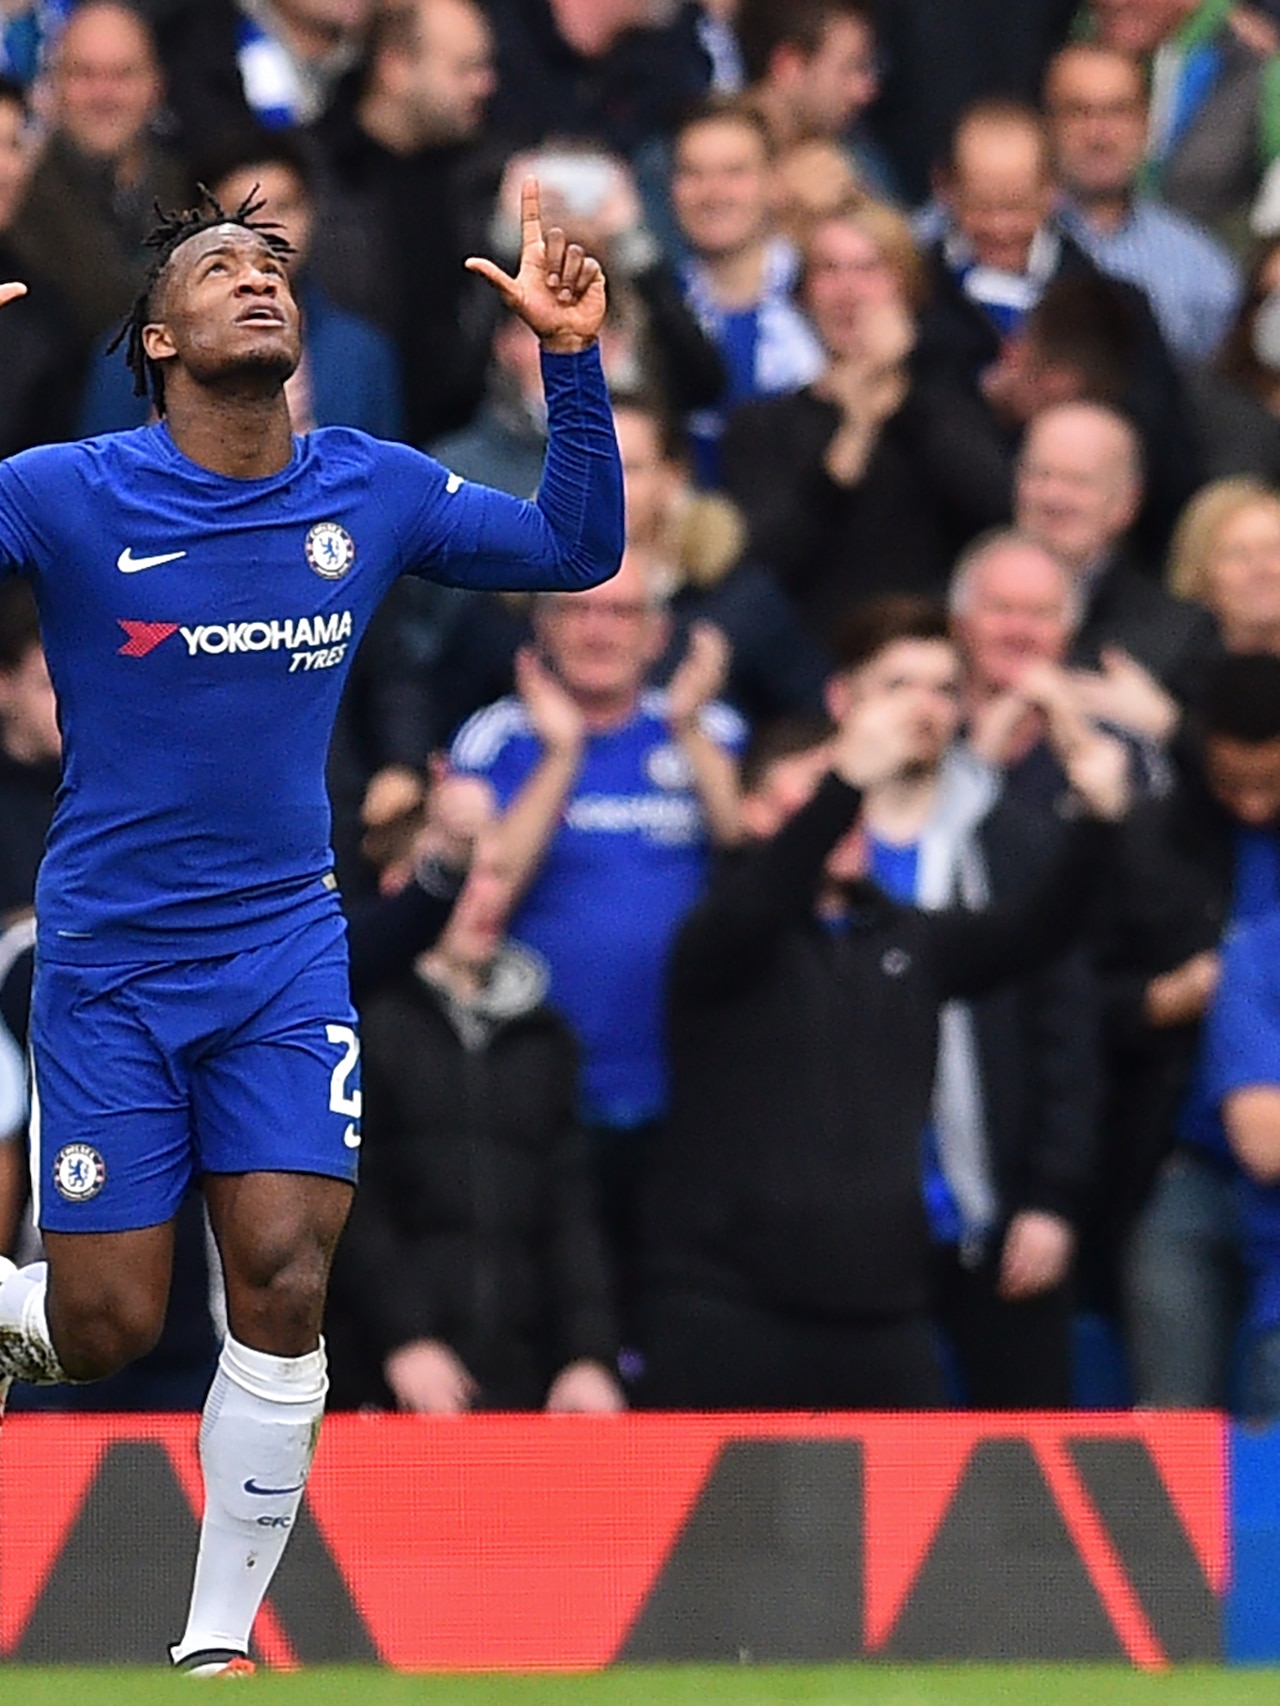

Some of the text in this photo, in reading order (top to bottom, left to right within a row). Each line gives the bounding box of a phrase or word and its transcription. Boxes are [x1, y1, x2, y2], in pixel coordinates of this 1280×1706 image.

[179, 611, 352, 656] YOKOHAMA
[288, 643, 348, 673] TYRES
[325, 1024, 362, 1119] 2
[257, 1516, 291, 1528] CFC
